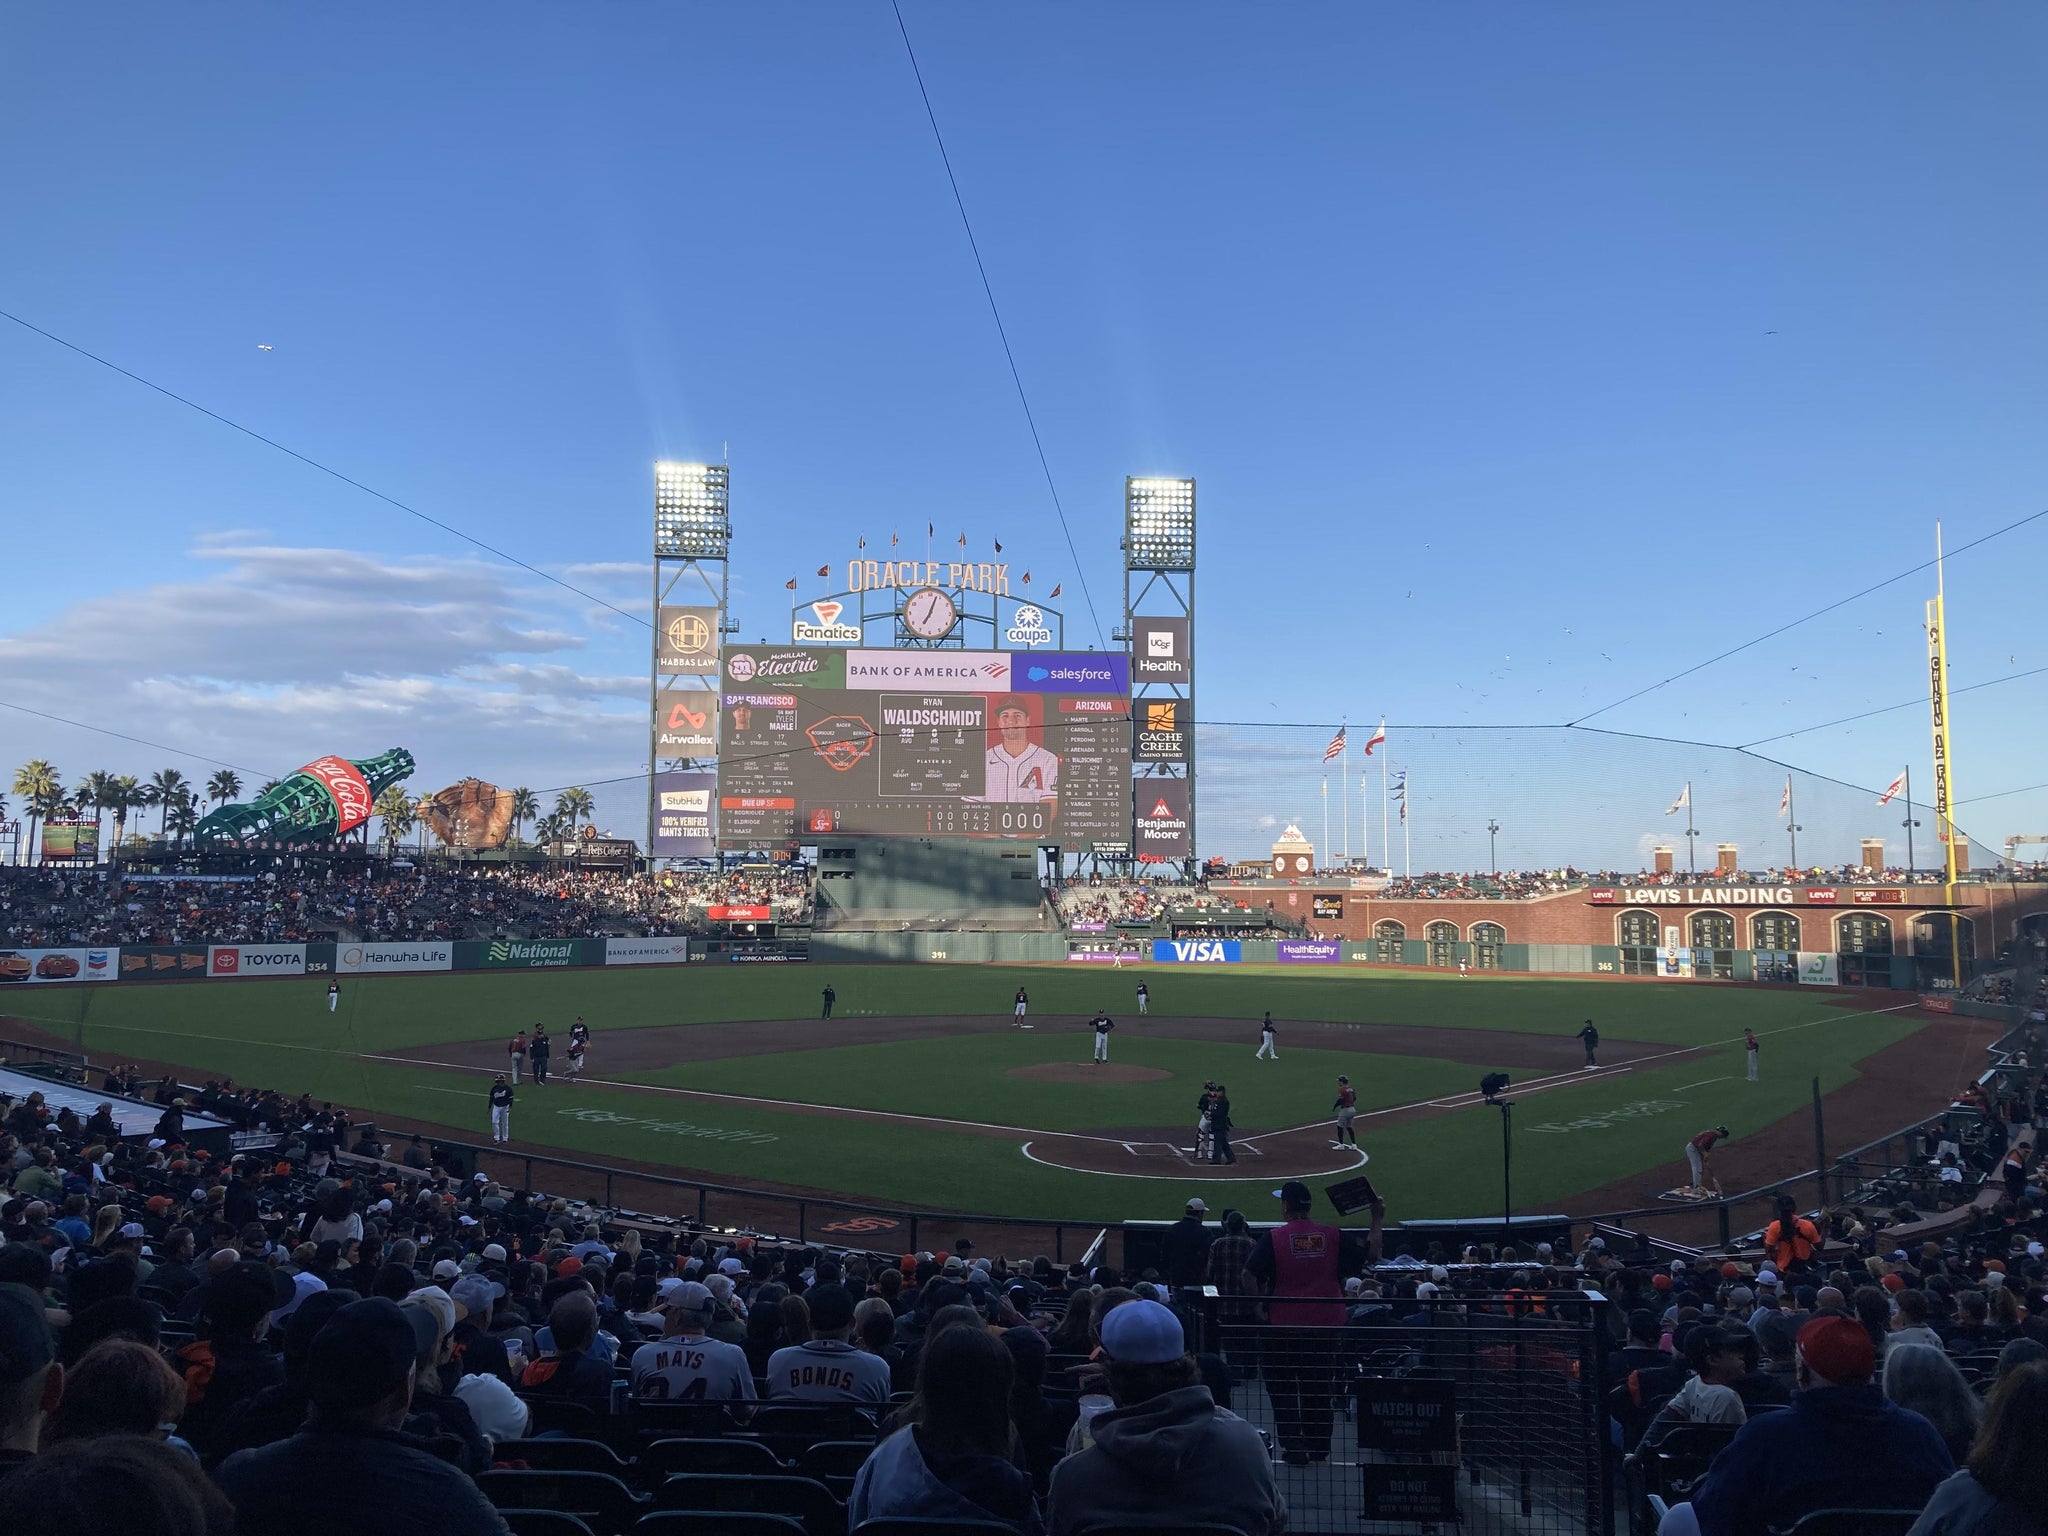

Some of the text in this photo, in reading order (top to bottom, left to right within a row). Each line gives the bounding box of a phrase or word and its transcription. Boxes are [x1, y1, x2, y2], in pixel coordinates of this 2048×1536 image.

[849, 560, 1010, 597] ORACLE PARK
[796, 624, 858, 639] Fanatics
[1009, 629, 1048, 644] coupa
[1150, 639, 1171, 650] UCSF
[770, 651, 806, 660] McMILLAN
[660, 658, 716, 667] HABBAS LAW
[757, 657, 819, 677] Electric
[1140, 660, 1182, 672] Health
[850, 666, 978, 678] BANK OF AMERICA
[1050, 667, 1112, 683] salesforce
[745, 696, 794, 705] FRANCISCO
[923, 698, 943, 706] RYAN
[1075, 701, 1112, 711] ARIZONA
[883, 709, 982, 726] WALDSCHMIDT
[769, 723, 794, 731] MAHLE
[660, 733, 714, 745] Airwallex
[1140, 732, 1183, 742] CACHE
[1931, 656, 1946, 813] CHIKIN IZ FARE
[1140, 742, 1181, 751] CREEK
[666, 796, 703, 805] StubHub
[661, 816, 708, 827] 100% VERIFIED
[834, 810, 1042, 829] 0 0 0 0 4 2 0 0 0
[1137, 818, 1186, 830] Benjamin
[659, 827, 710, 837] GIANTS TICKETS
[948, 822, 954, 830] 0
[973, 822, 978, 831] 4
[984, 822, 990, 831] 2
[1144, 830, 1179, 839] Moore
[604, 845, 622, 856] Coffee
[1139, 852, 1165, 864] Coors
[1688, 888, 1793, 904] LANDING
[1322, 899, 1343, 909] Sports
[727, 908, 752, 916] Adobe
[509, 943, 572, 960] National
[1171, 942, 1226, 962] VISA
[1283, 944, 1337, 956] HealthEquity
[244, 954, 301, 966] TOYOTA
[366, 952, 446, 963] Hanwha Life
[530, 958, 569, 967] Car Rental
[1352, 953, 1367, 961] 415
[308, 962, 328, 972] 354
[1598, 962, 1613, 971] 365
[1932, 979, 1955, 988] 309
[1926, 1000, 1949, 1008] ORACLE
[656, 1350, 705, 1370] MAYS
[790, 1366, 855, 1391] BONDS
[1371, 1402, 1442, 1418] WATCH OUT
